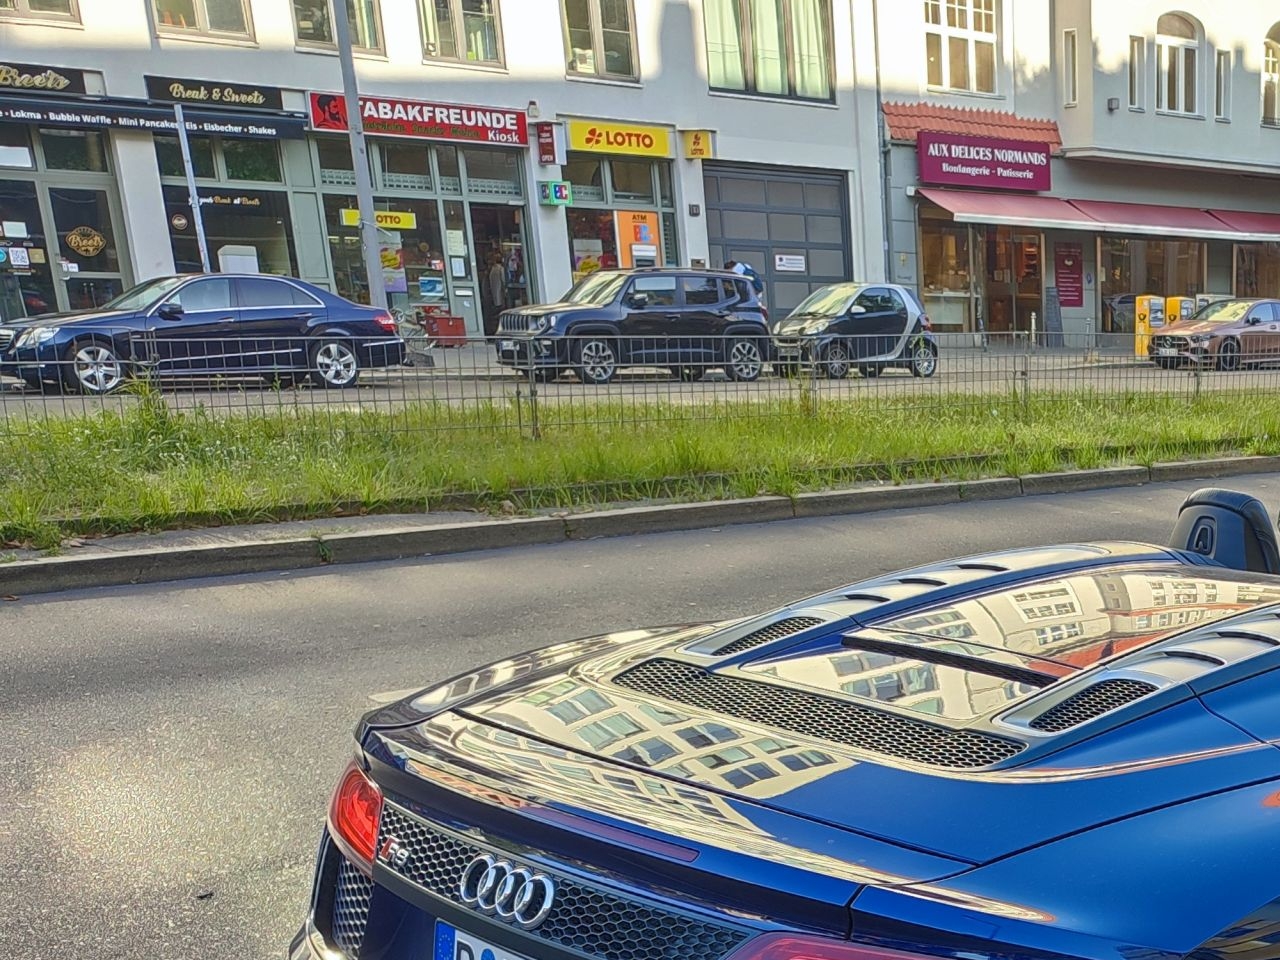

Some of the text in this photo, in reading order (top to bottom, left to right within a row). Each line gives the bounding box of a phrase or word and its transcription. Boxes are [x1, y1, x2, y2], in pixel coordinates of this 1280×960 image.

[169, 83, 266, 104] Break & Sweets
[10, 109, 42, 120] Lokma
[49, 111, 81, 122] Bubble
[81, 114, 112, 124] Waffle
[118, 117, 138, 127] Mini
[186, 121, 197, 131] Eis
[204, 123, 242, 134] Eisbecher
[248, 126, 277, 136] Shakes
[488, 130, 520, 144] Kiosk
[606, 131, 654, 149] LOTTO
[690, 147, 704, 156] LOTTO
[928, 143, 1047, 166] AUX DELICES NORMANDS
[942, 162, 990, 176] Boulangerie
[997, 167, 1034, 179] Patisserie
[376, 214, 401, 224] OTTO
